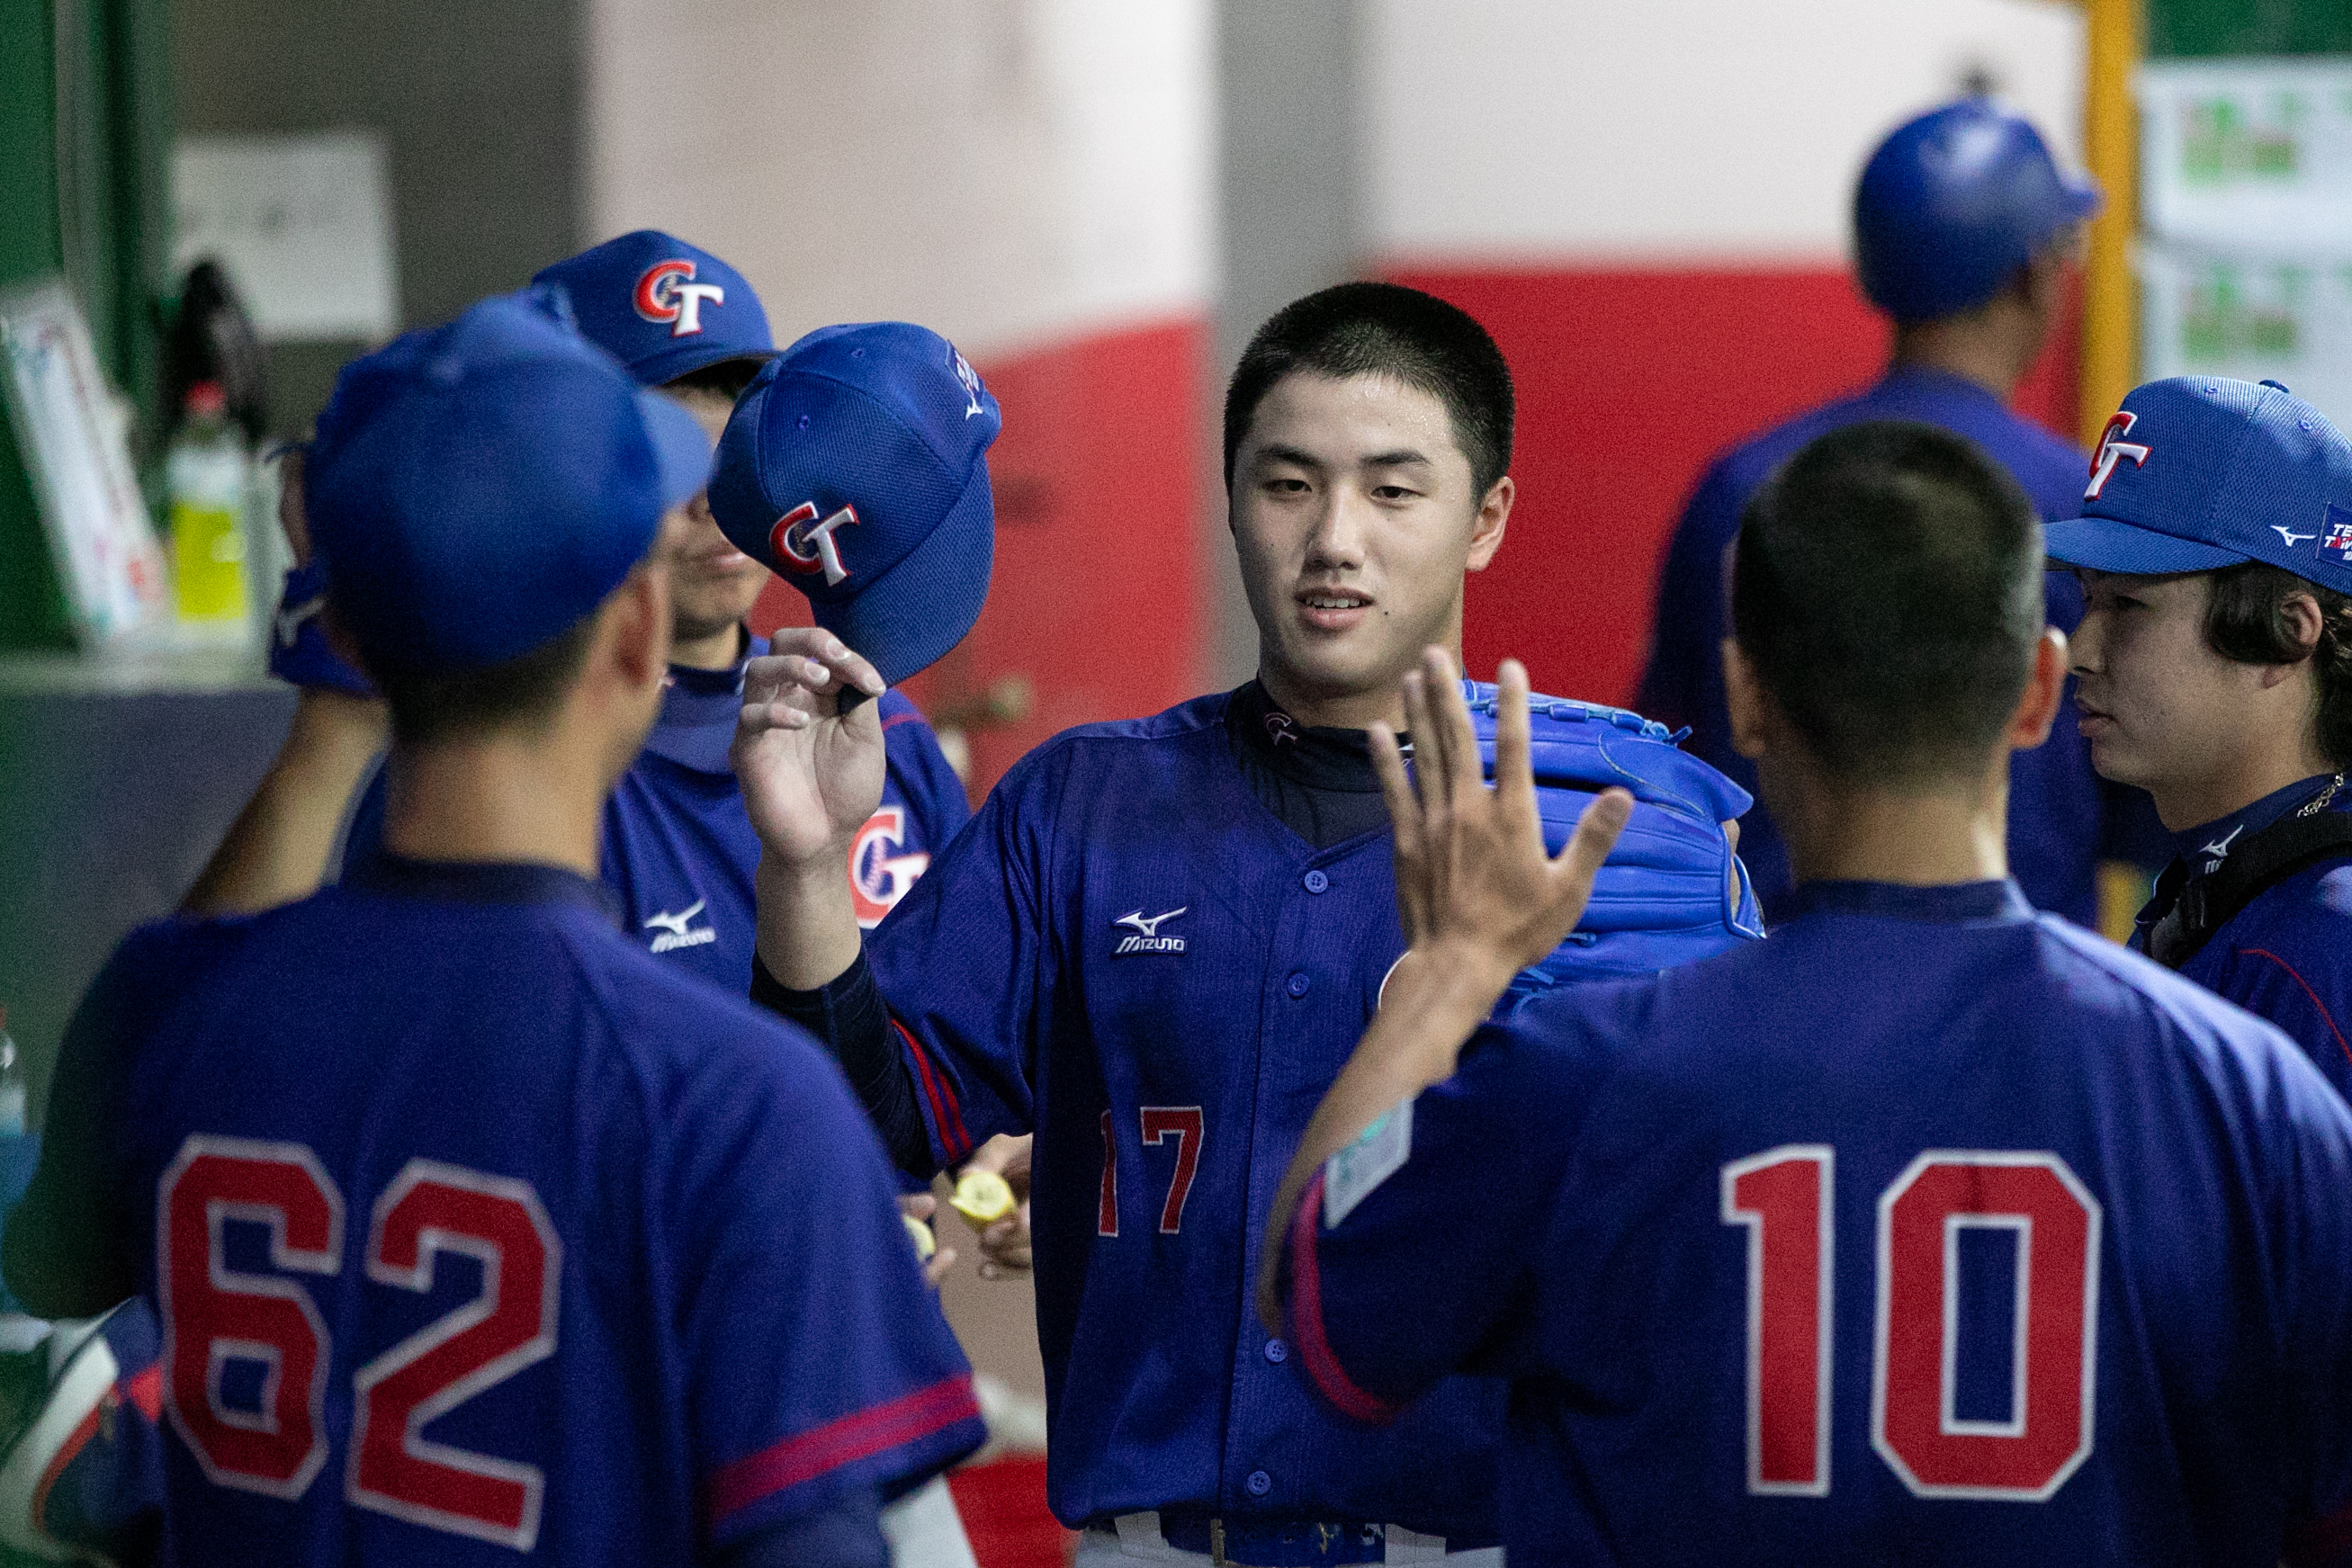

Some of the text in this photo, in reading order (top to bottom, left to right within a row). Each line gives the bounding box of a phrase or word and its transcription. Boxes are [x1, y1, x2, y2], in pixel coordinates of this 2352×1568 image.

[2333, 523, 2352, 540] TE
[1115, 936, 1185, 954] MIZUNO
[1098, 1106, 1205, 1238] 17
[158, 1132, 564, 1554] 62
[1719, 1142, 2103, 1503] 10
